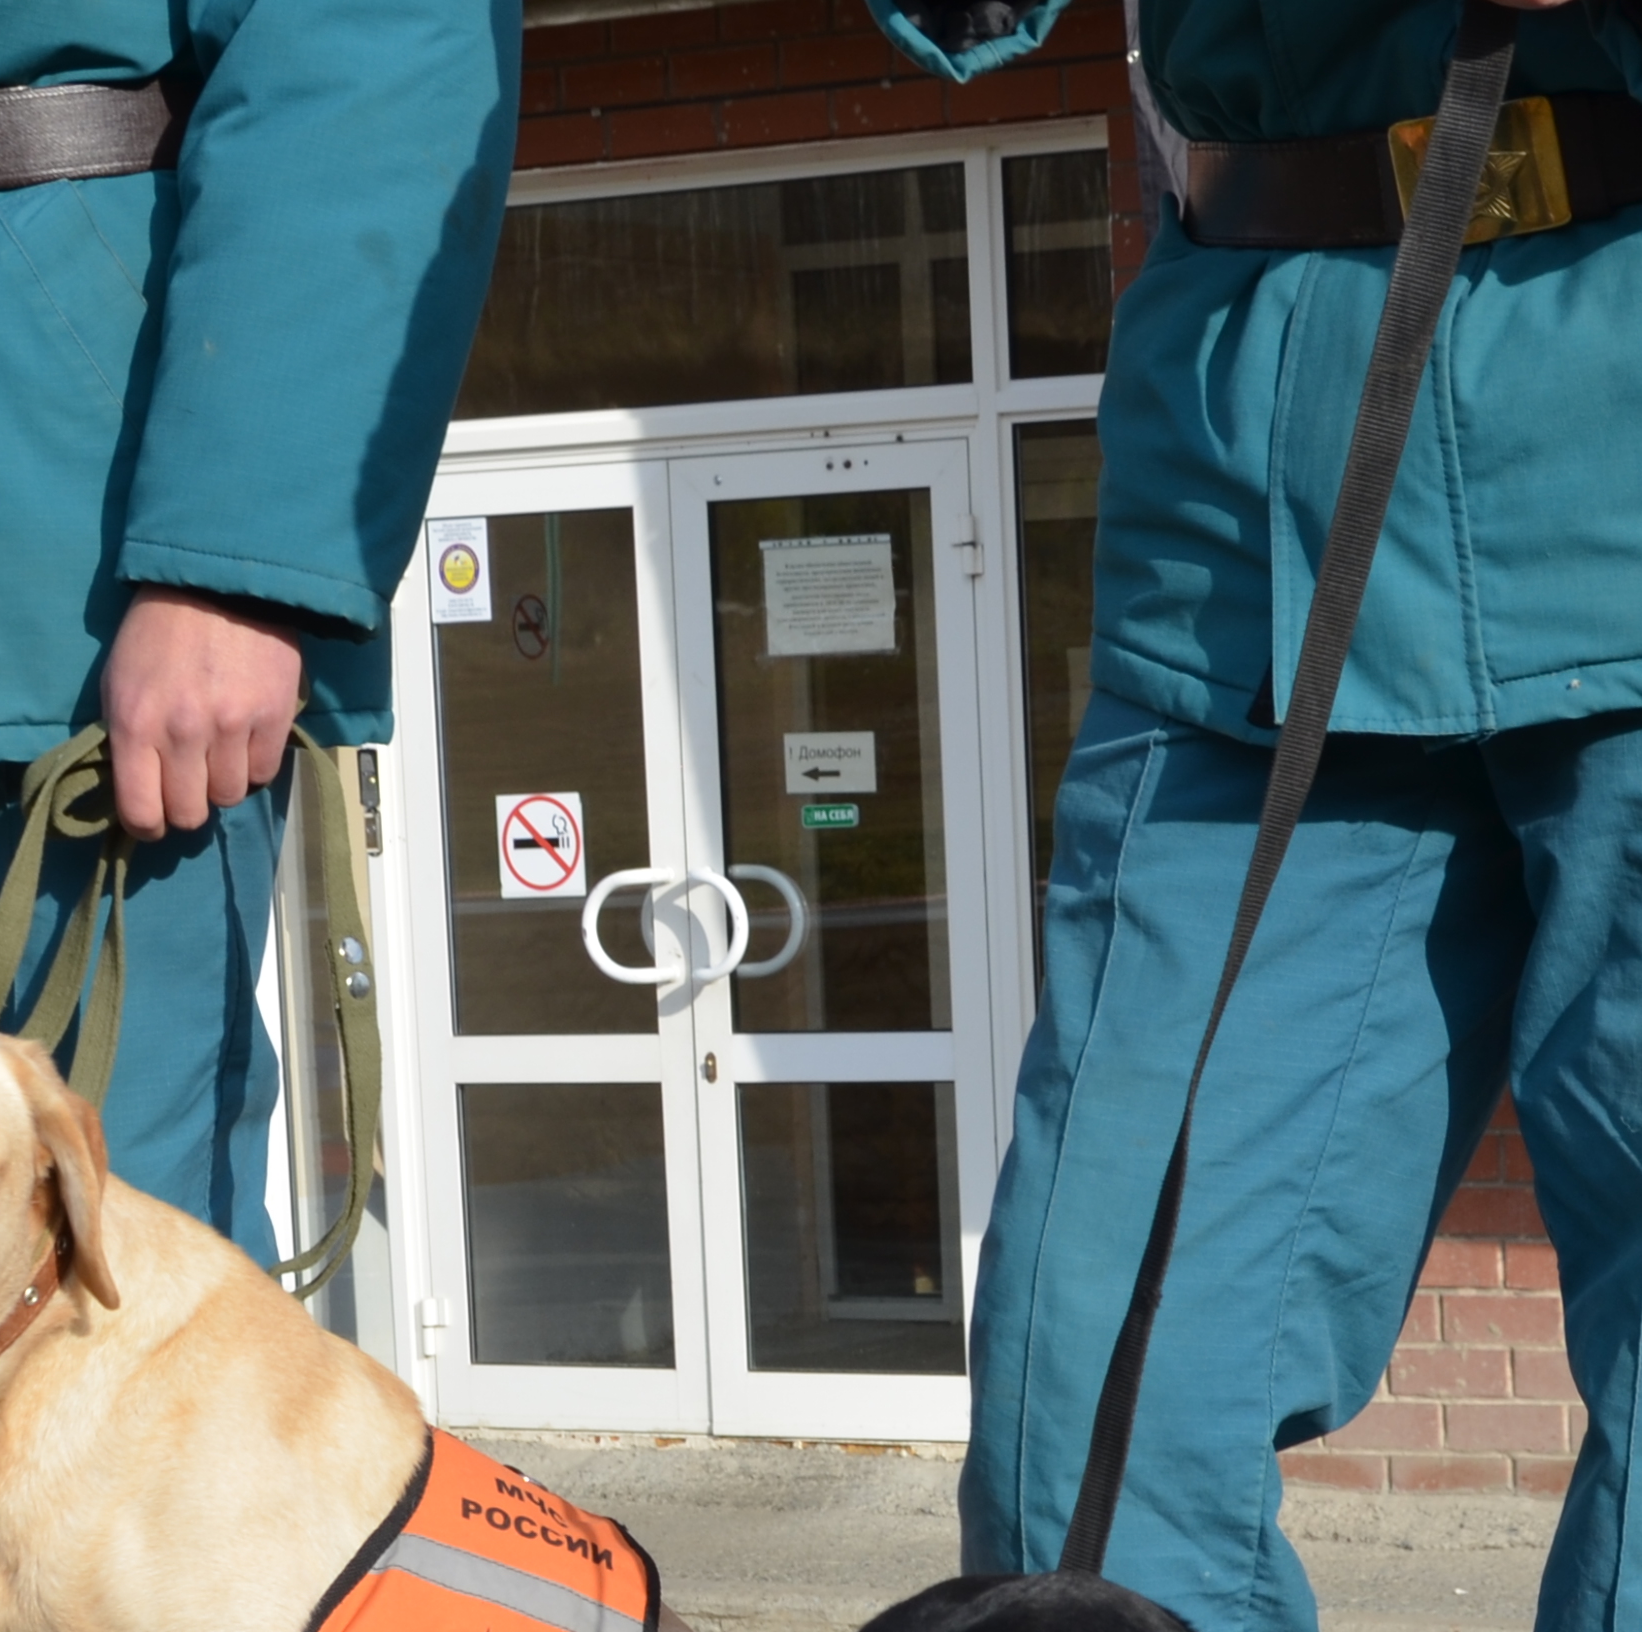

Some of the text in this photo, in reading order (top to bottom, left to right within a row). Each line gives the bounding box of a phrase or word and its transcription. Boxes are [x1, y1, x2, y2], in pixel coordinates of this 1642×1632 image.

[799, 745, 861, 761] Домофон
[814, 809, 854, 821] НА СЕБЯ
[495, 1477, 568, 1528] МЧС
[461, 1497, 614, 1571] РОССИИ
